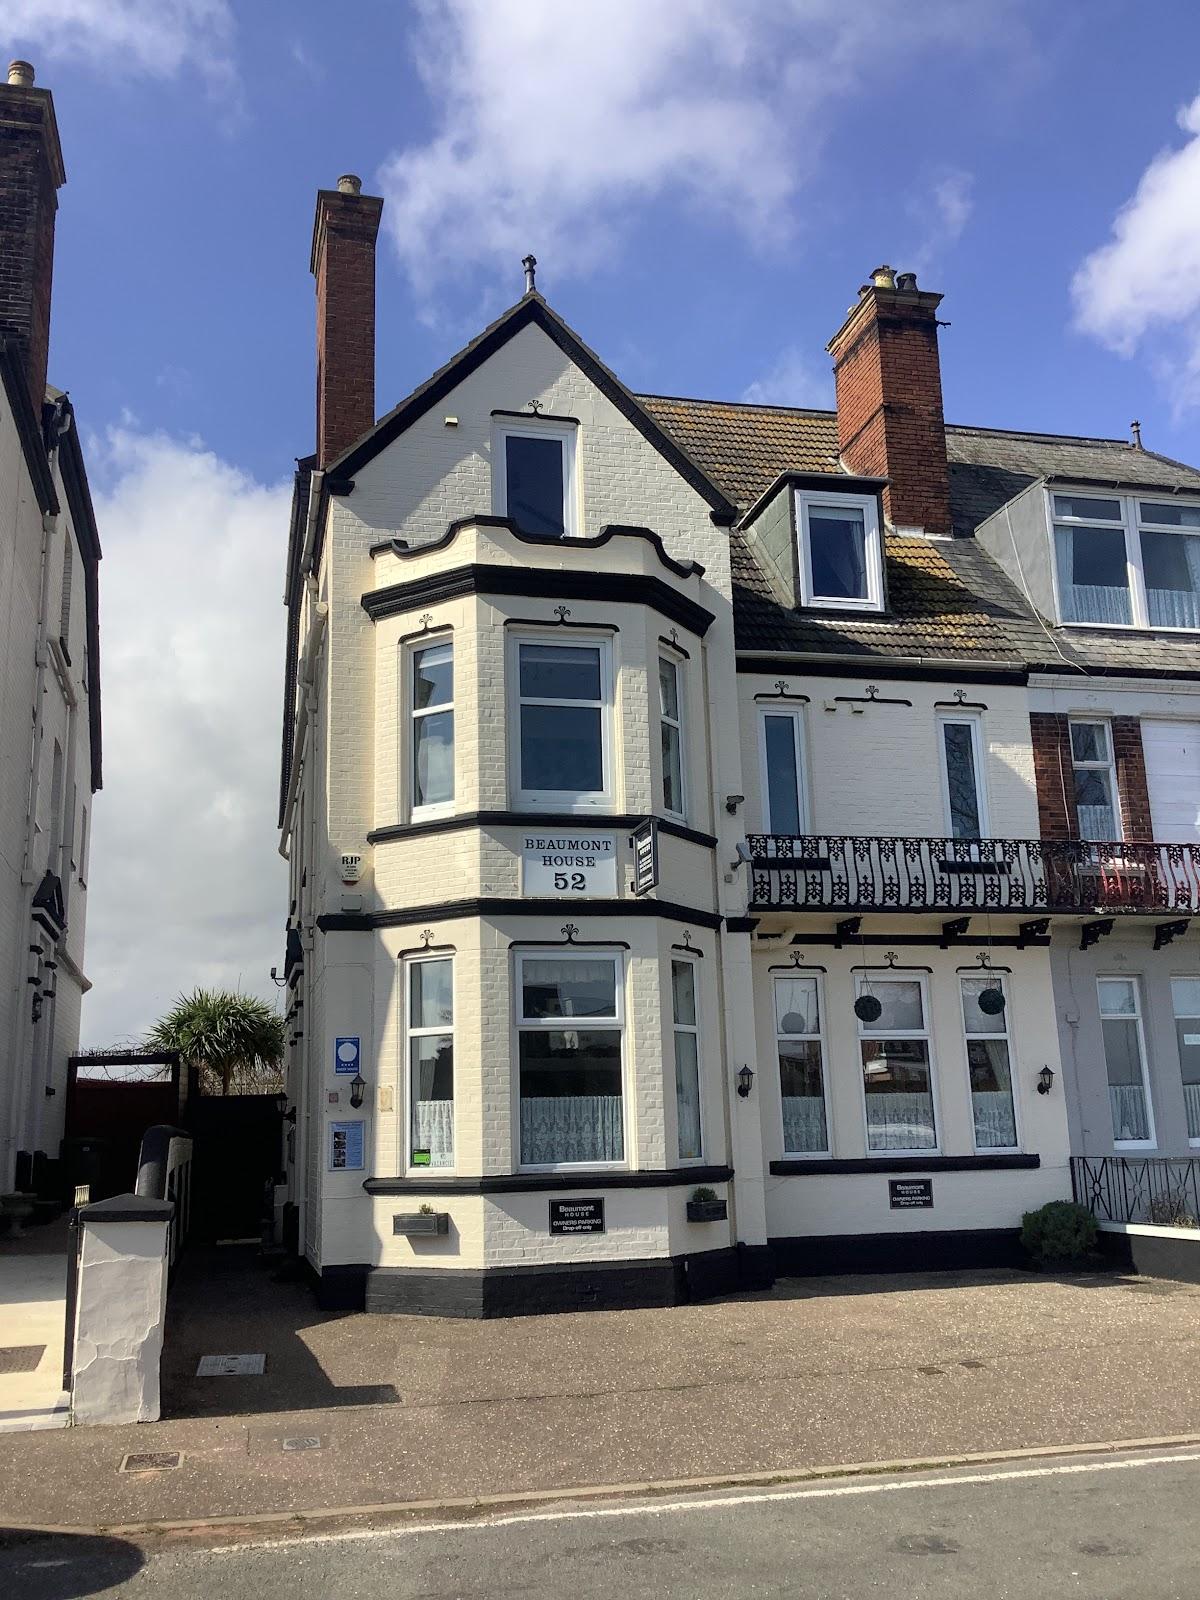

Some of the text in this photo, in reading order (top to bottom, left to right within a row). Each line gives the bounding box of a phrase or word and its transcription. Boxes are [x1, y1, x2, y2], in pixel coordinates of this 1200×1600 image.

[525, 838, 612, 851] BEAUMONT
[341, 856, 361, 865] RJP
[542, 856, 596, 867] HOUSE
[554, 872, 586, 891] 52
[559, 1205, 595, 1213] Beaumont
